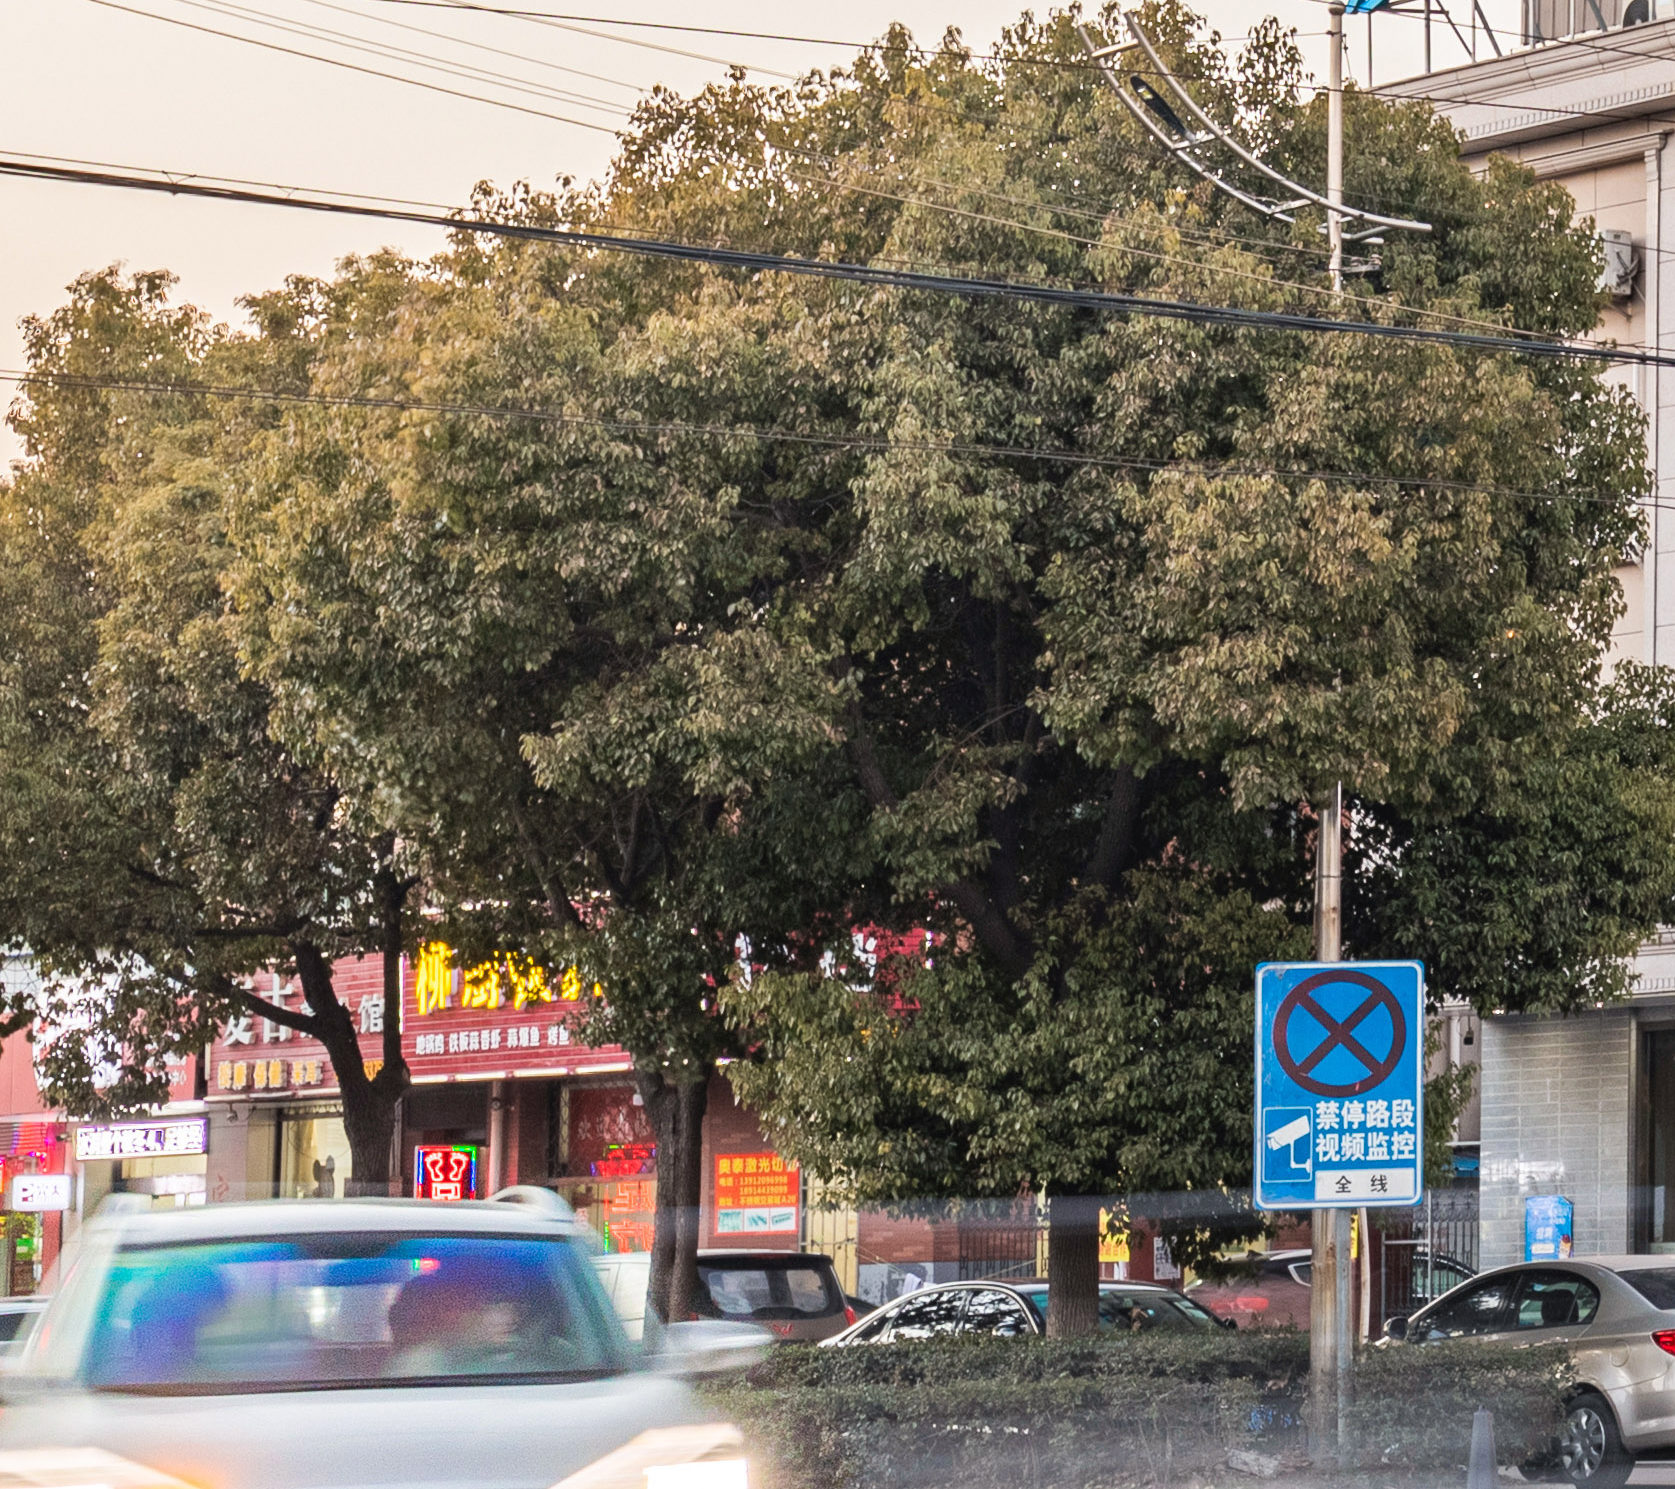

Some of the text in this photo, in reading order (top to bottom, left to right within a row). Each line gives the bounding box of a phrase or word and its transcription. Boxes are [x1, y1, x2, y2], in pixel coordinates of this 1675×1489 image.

[1315, 1099, 1415, 1130] 禁停路段
[1315, 1131, 1415, 1162] 视频监控
[1335, 1175, 1388, 1194] 全线
